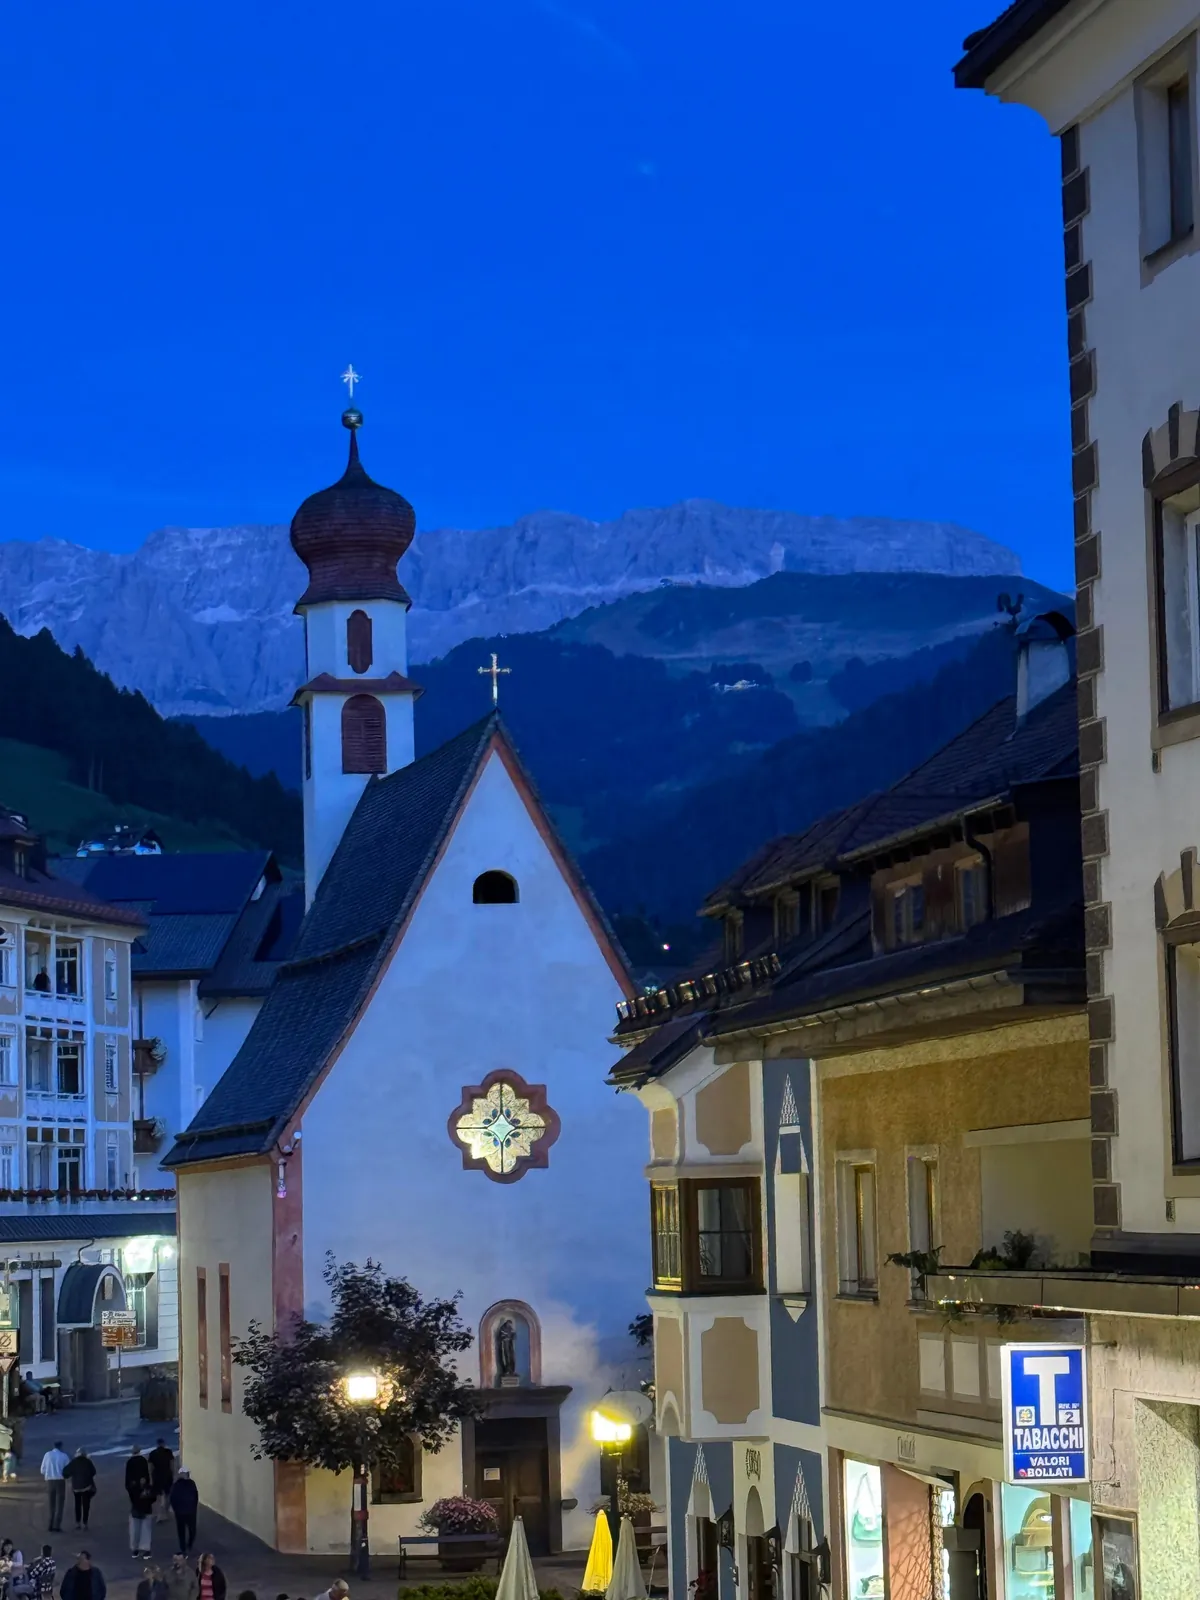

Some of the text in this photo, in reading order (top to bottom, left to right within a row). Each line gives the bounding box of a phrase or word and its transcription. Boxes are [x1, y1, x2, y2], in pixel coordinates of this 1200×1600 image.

[1023, 1356, 1070, 1426] T
[1064, 1411, 1074, 1423] 2
[1014, 1427, 1084, 1450] TABACCHI
[1030, 1456, 1070, 1466] VALORI
[1027, 1467, 1073, 1477] BOLLATI
